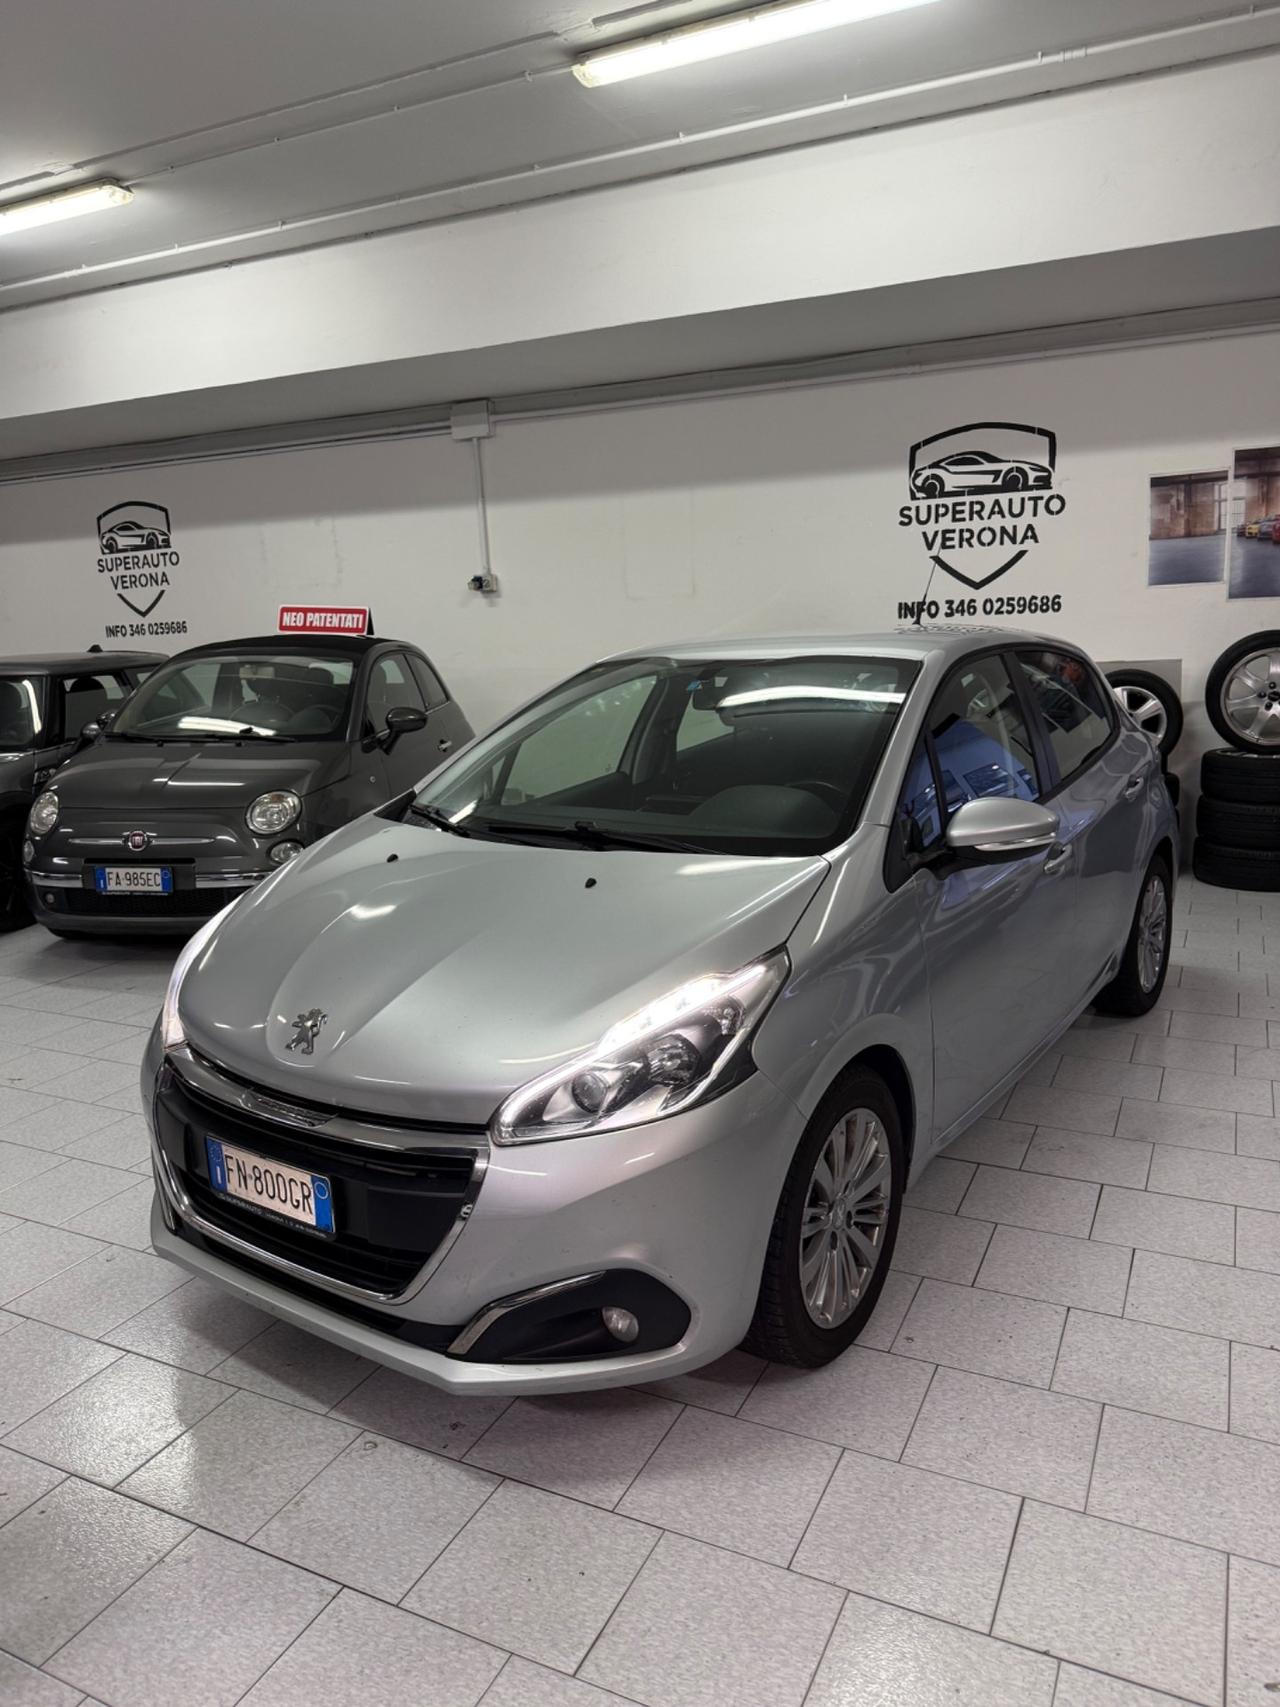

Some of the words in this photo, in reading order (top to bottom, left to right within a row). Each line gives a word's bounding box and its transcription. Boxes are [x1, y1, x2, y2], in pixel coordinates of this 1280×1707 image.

[899, 494, 1065, 526] SUPERAUTO
[922, 524, 1039, 550] VERONA
[97, 551, 179, 572] SUPERAUTO
[110, 571, 170, 589] VERONA
[944, 599, 977, 618] 346
[982, 595, 1062, 615] 0259686
[105, 624, 127, 638] INFO
[129, 623, 146, 636] 346
[148, 621, 187, 635] 0259686
[282, 612, 304, 626] NEO
[306, 612, 363, 628] PATENTATI
